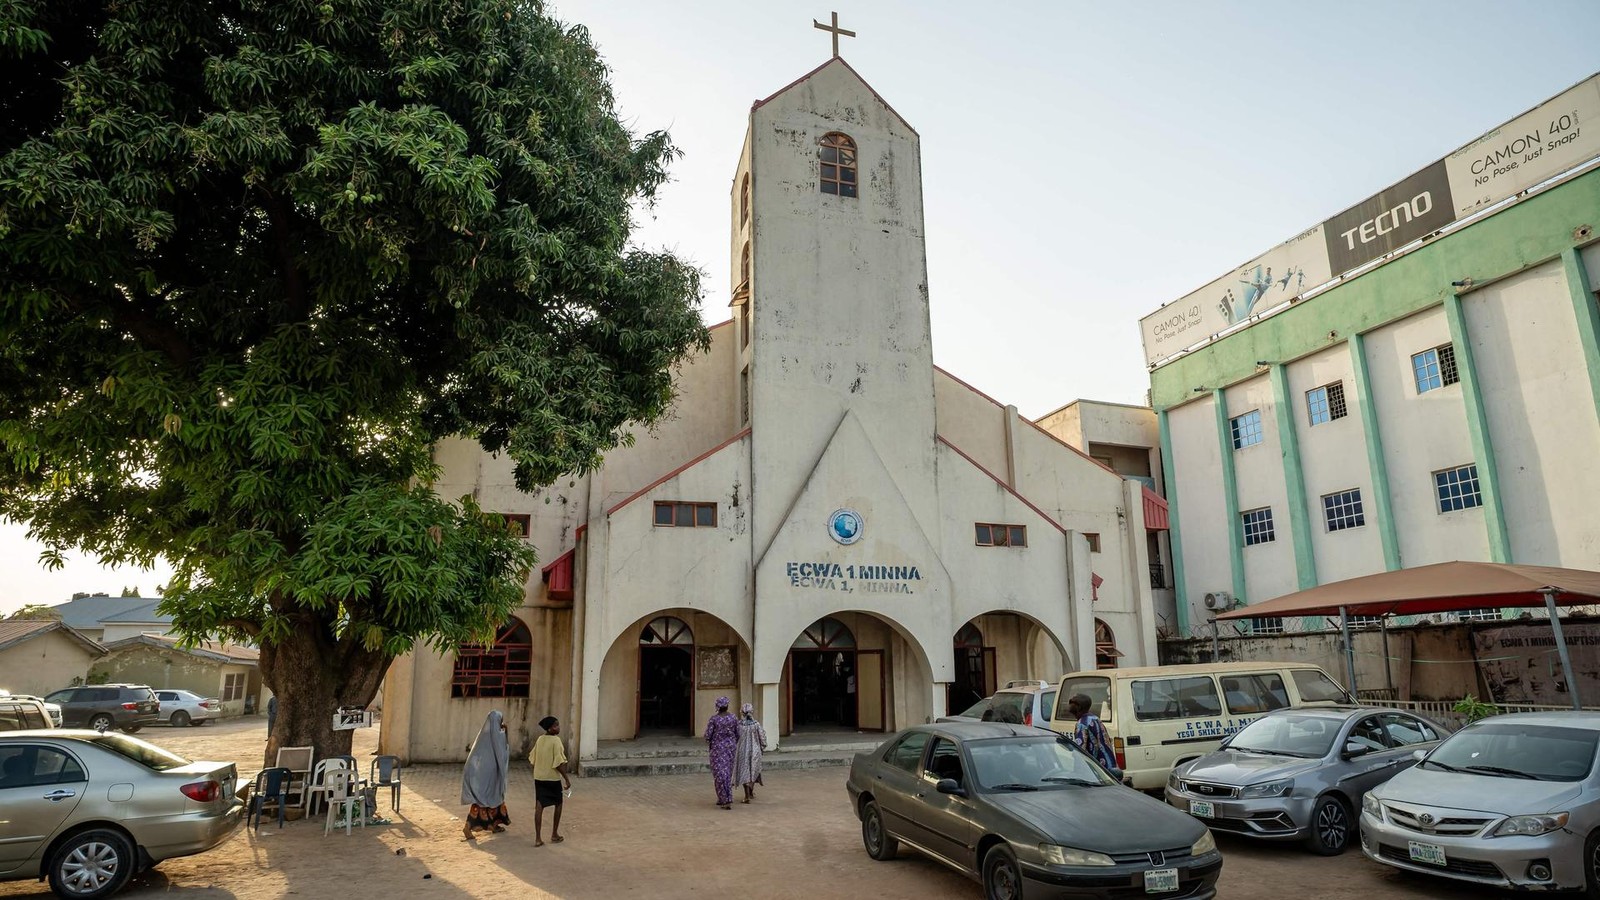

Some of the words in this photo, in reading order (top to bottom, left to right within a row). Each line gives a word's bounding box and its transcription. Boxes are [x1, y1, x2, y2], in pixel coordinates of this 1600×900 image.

[1471, 130, 1541, 175] CAMON
[1549, 115, 1571, 135] 40
[1474, 175, 1489, 187] No
[1493, 162, 1519, 178] Pose,
[1523, 147, 1543, 163] Just
[1548, 128, 1580, 151] Snap!
[1341, 191, 1432, 250] TECNO
[1153, 312, 1185, 335] CAMON
[1189, 305, 1198, 317] 40
[787, 562, 843, 578] ECWA
[791, 576, 835, 590] ECWA
[841, 580, 854, 594] 1,
[1525, 637, 1529, 647] 1
[1177, 730, 1195, 738] YESU
[1198, 728, 1221, 736] SHINE
